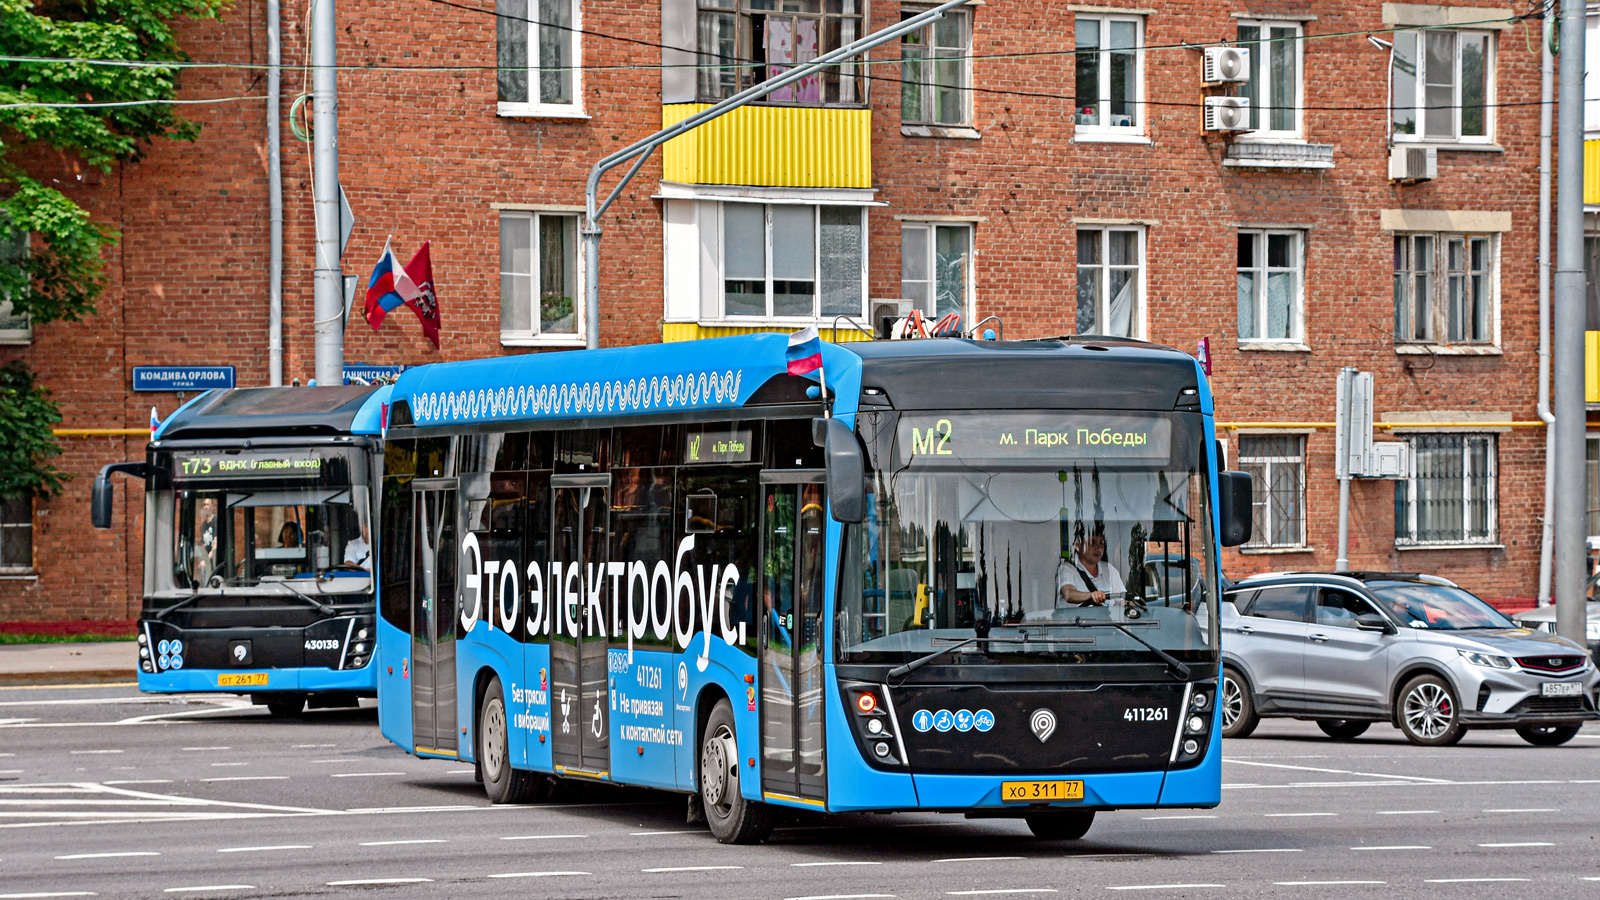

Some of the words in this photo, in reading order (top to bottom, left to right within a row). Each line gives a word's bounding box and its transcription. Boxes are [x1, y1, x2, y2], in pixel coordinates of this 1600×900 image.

[140, 371, 187, 381] КОМДИВА
[188, 371, 226, 381] ОРЛОВА
[1025, 428, 1069, 448] Парк
[1076, 428, 1147, 447] Победы
[219, 459, 247, 471] ВДНХ
[460, 532, 519, 634] Это
[304, 640, 340, 650] 430138
[236, 674, 252, 684] 261
[637, 665, 662, 690] 411261
[512, 683, 524, 703] Без
[525, 688, 547, 708] тряски
[620, 692, 630, 714] Не
[631, 698, 664, 719] привязан
[518, 709, 550, 734] вибраций
[1123, 707, 1168, 721] 411261
[620, 724, 625, 740] к
[626, 723, 666, 744] контактной
[666, 729, 683, 746] сети
[1032, 783, 1057, 797] 311
[1066, 782, 1079, 793] 77
